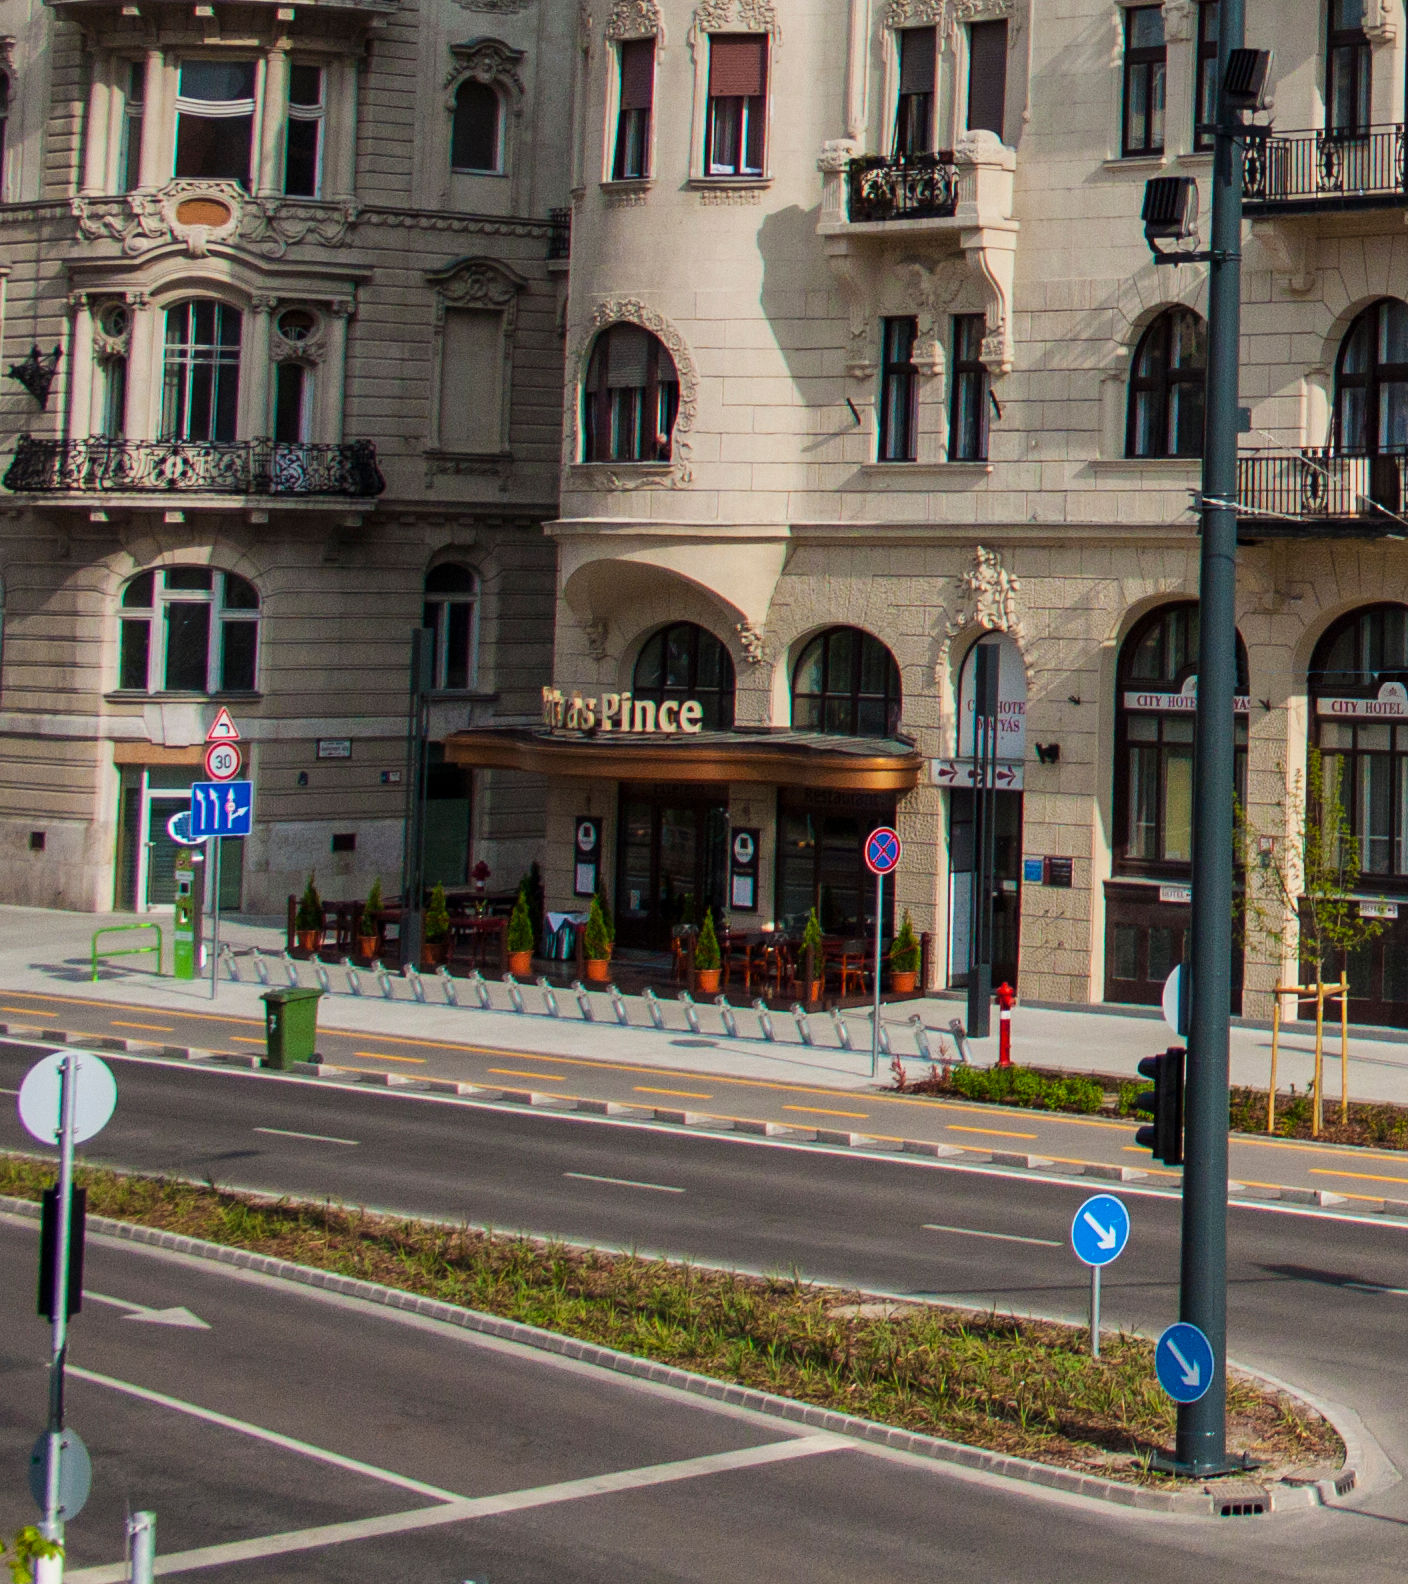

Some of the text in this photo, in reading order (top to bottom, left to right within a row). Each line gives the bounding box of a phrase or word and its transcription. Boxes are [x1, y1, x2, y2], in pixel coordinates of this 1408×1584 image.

[1136, 695, 1196, 708] CITY HOTE
[1331, 700, 1358, 713] CITY
[1365, 702, 1404, 714] HOTEL
[601, 691, 704, 733] Pince
[215, 754, 232, 769] 30
